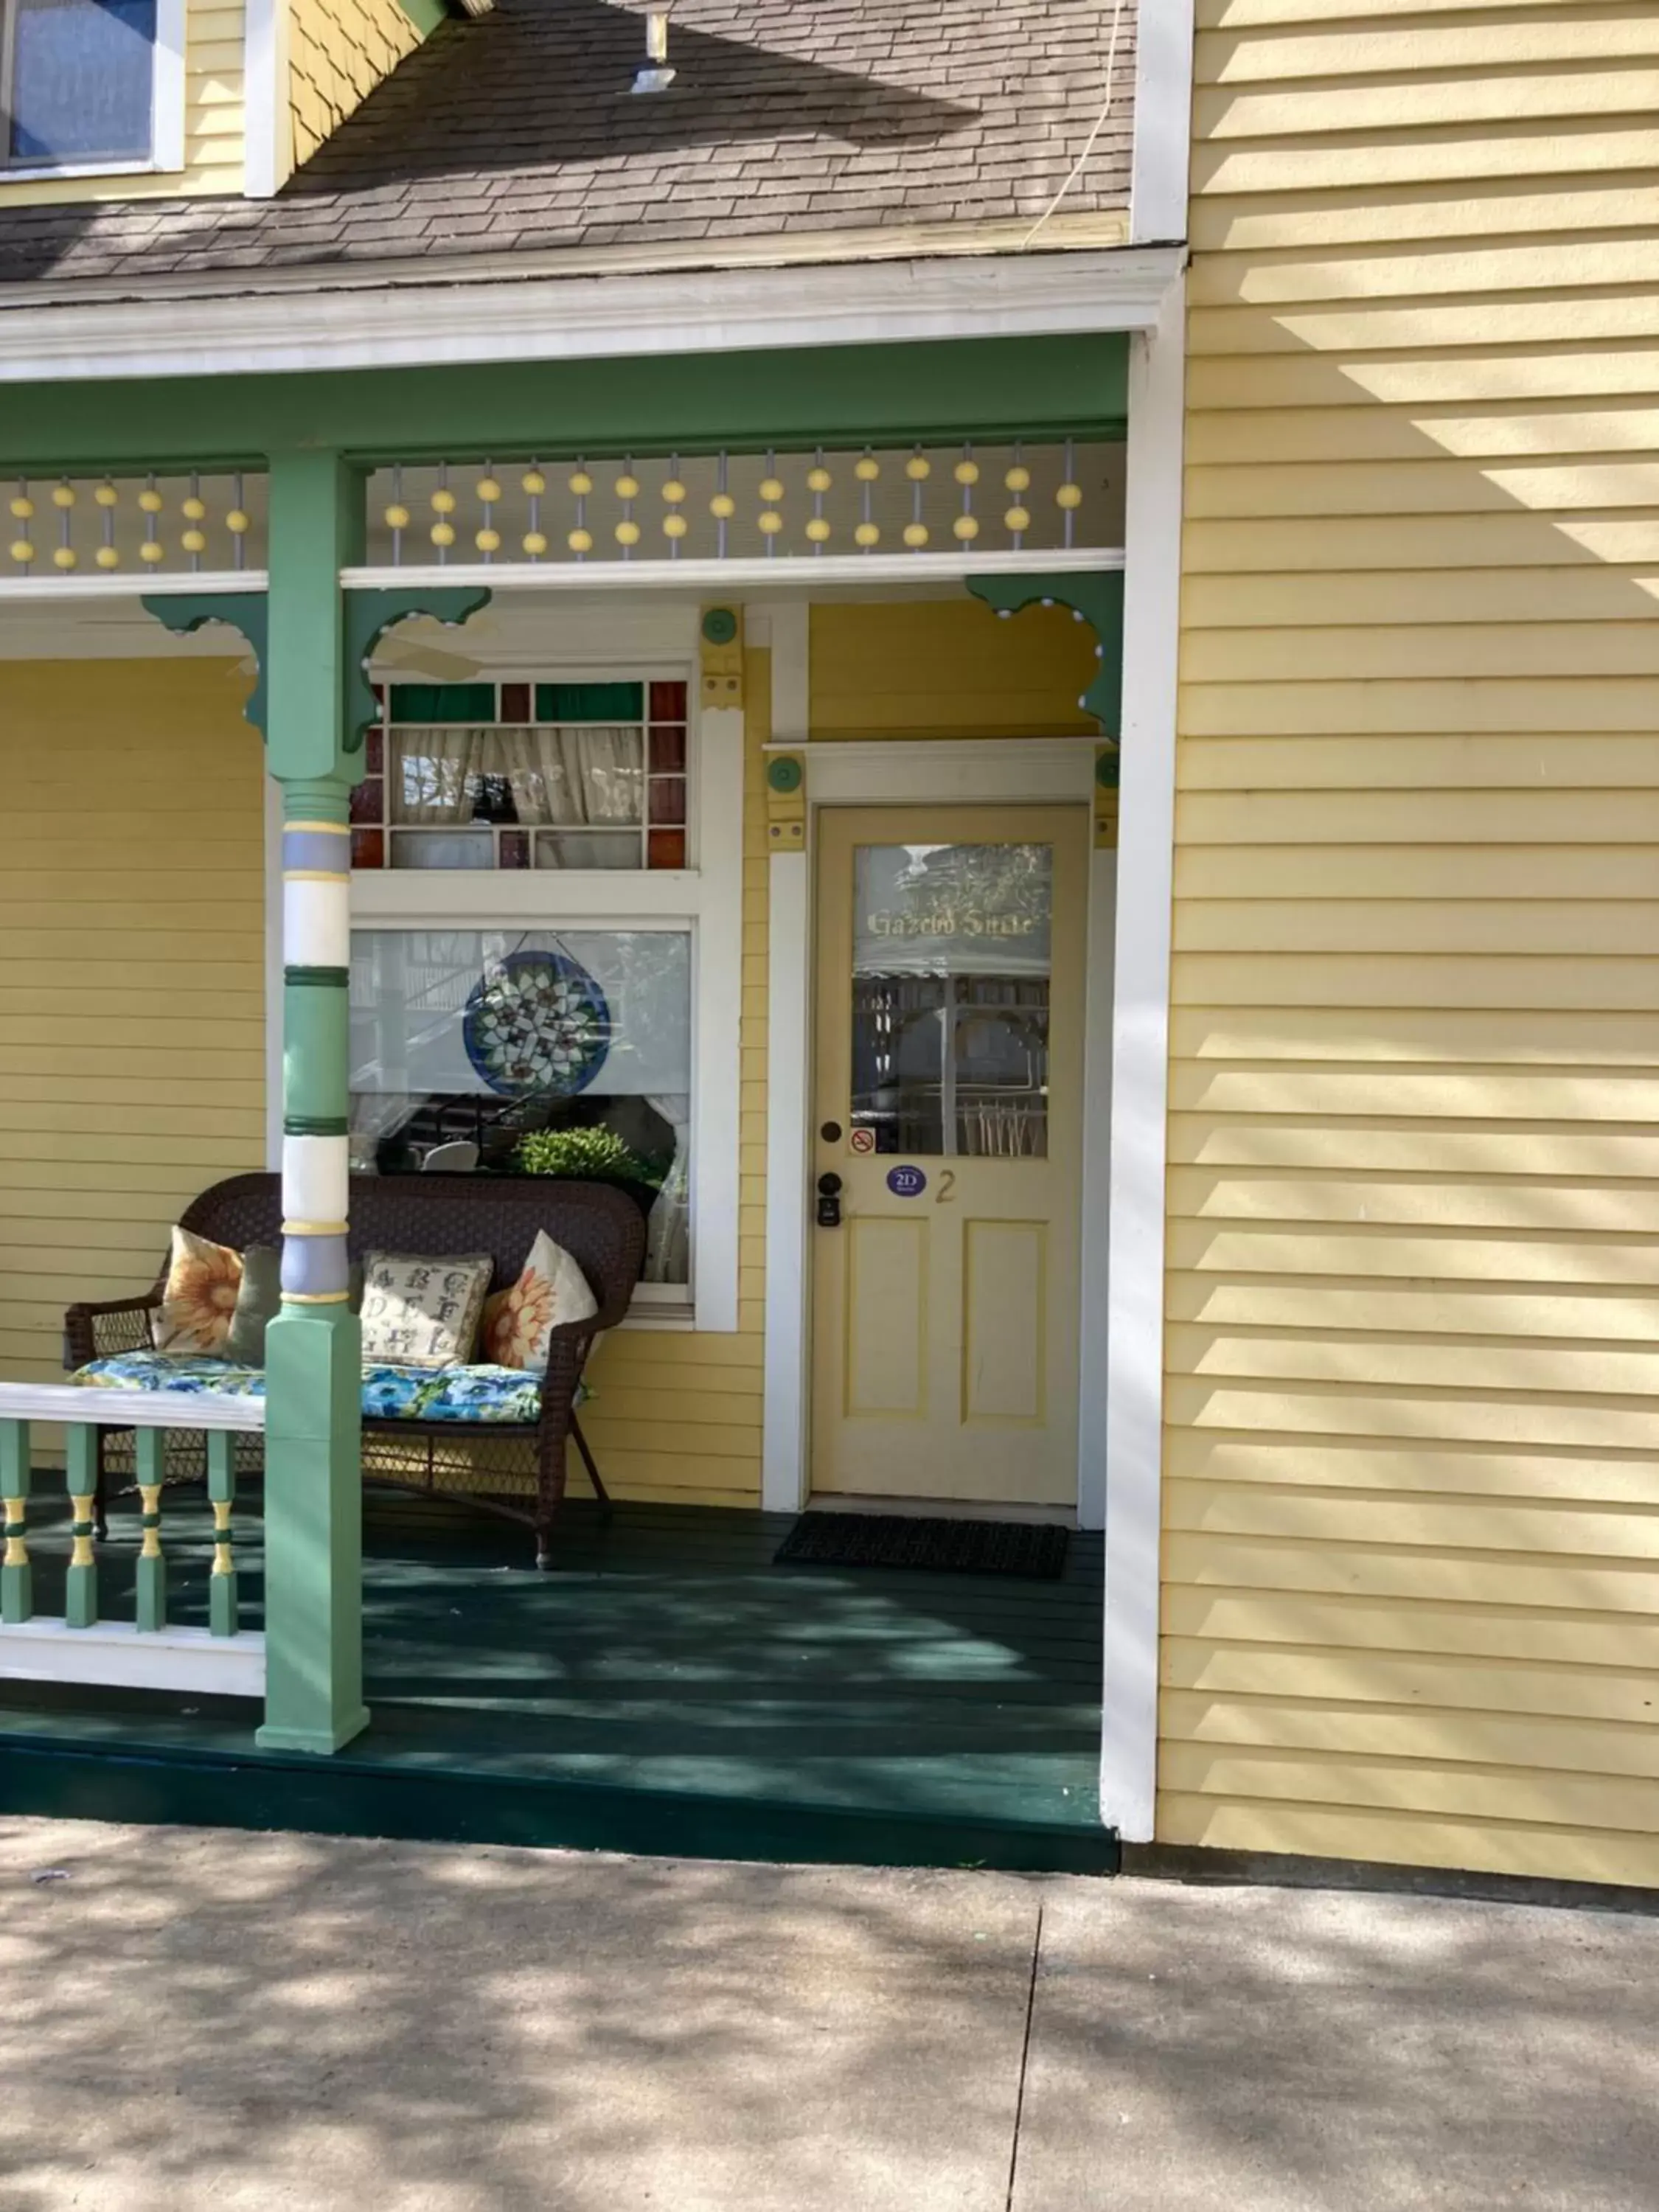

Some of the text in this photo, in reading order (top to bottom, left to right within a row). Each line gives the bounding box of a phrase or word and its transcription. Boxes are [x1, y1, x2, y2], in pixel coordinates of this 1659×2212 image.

[867, 909, 1034, 937] Gazebo Suite
[936, 1169, 956, 1204] 2
